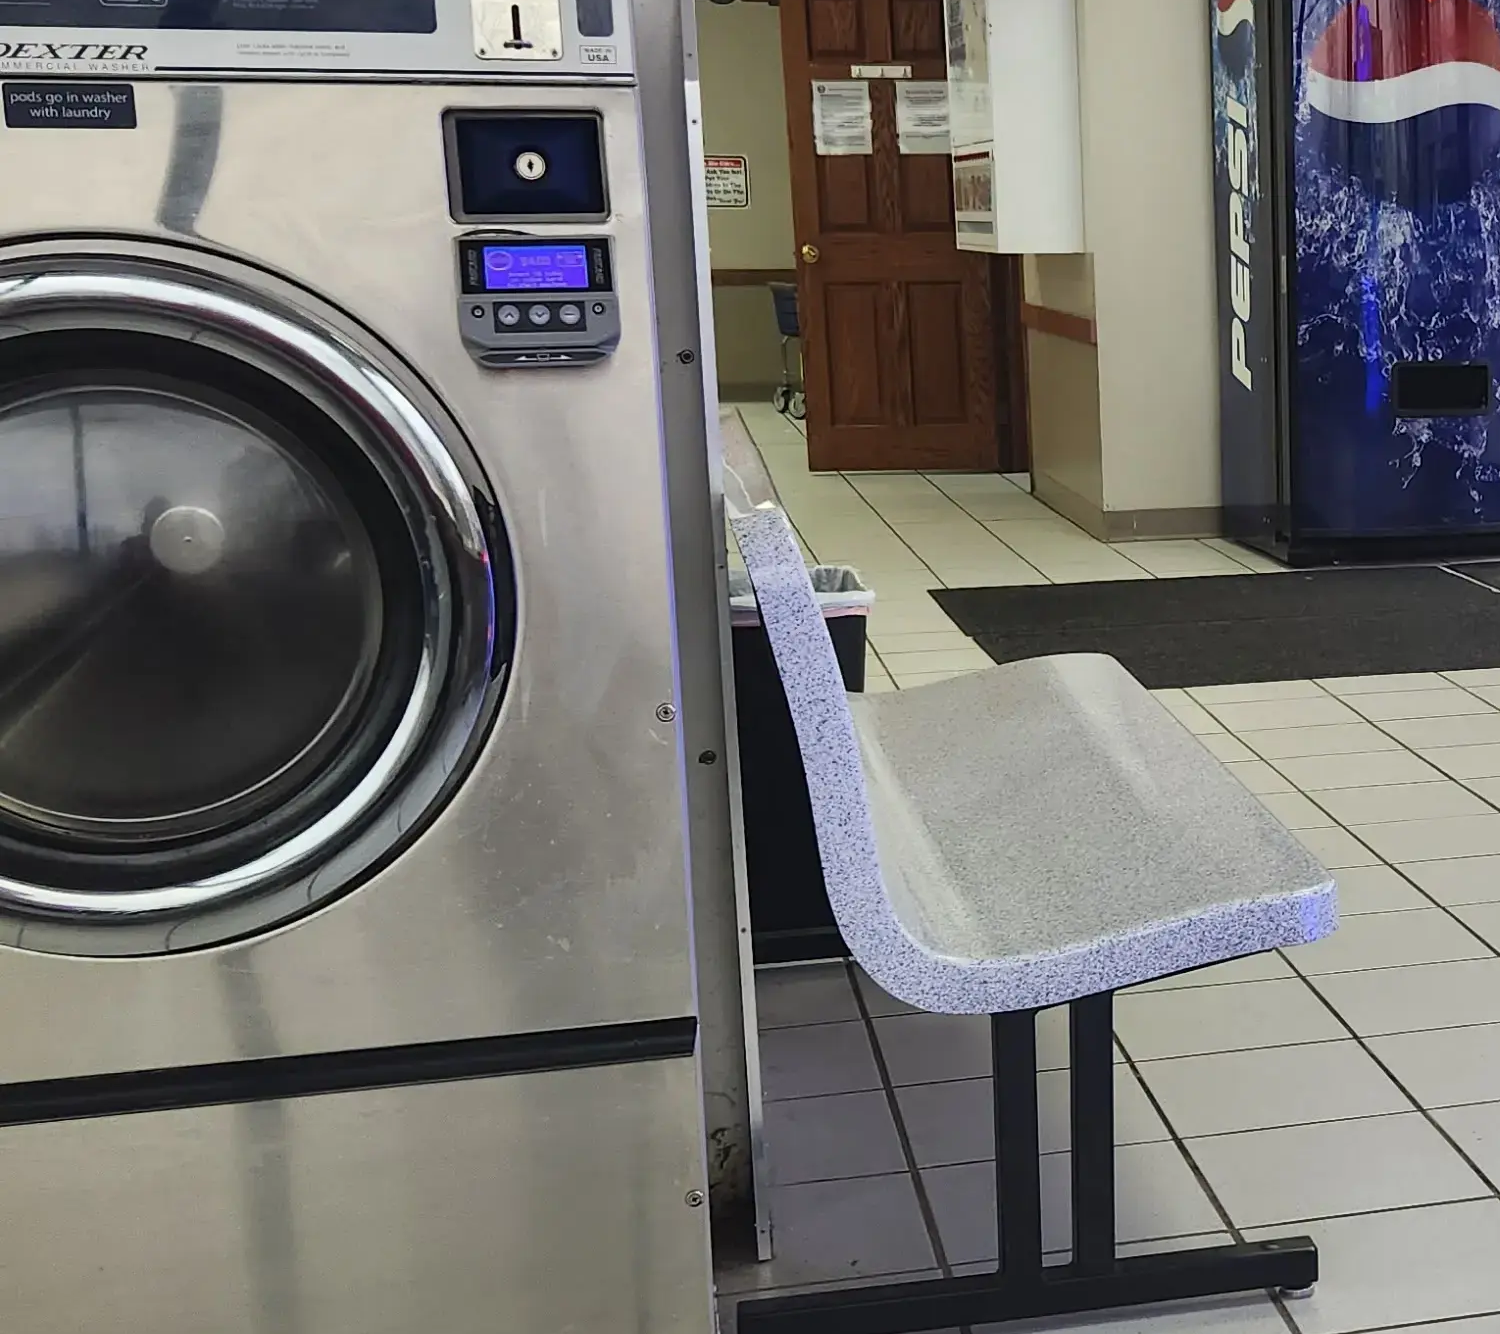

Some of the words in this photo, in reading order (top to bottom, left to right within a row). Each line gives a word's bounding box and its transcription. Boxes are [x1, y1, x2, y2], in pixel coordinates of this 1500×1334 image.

[588, 54, 609, 62] USA
[88, 63, 150, 71] WASHER
[10, 92, 42, 104] pods
[46, 93, 63, 105] go
[67, 92, 79, 102] in
[82, 92, 128, 103] washer
[30, 106, 59, 117] with
[62, 106, 112, 120] laundry
[1226, 97, 1254, 392] PEPSI
